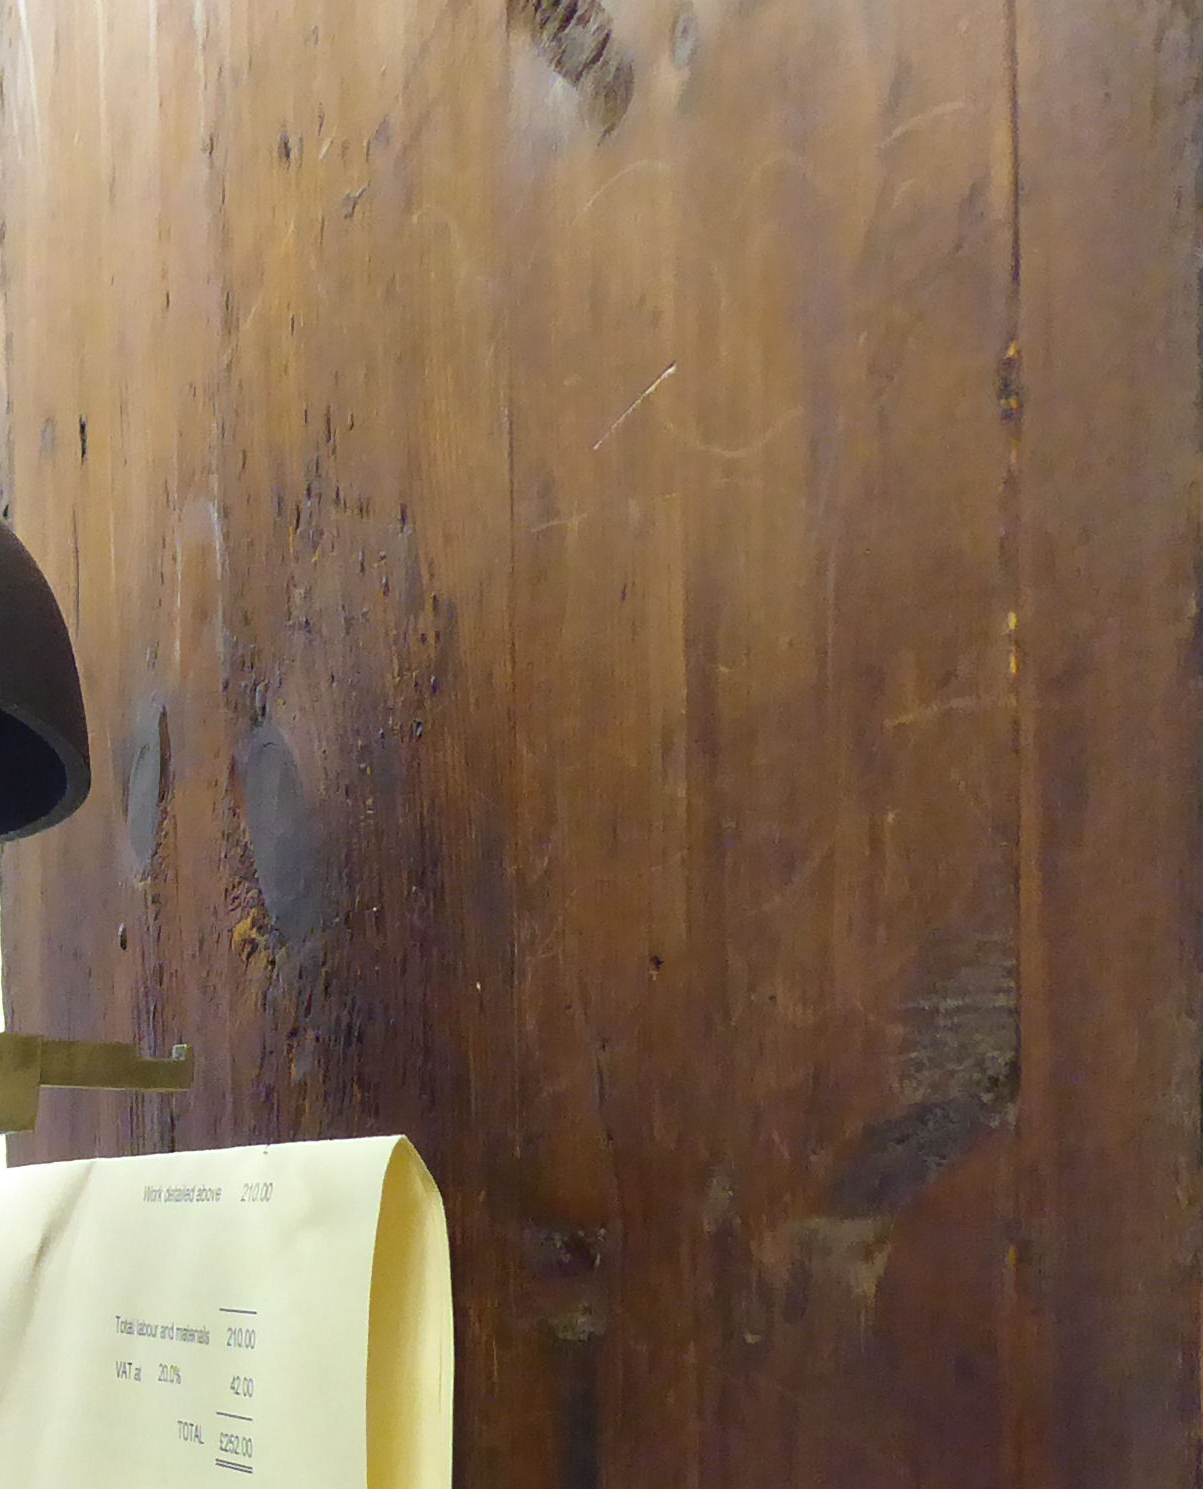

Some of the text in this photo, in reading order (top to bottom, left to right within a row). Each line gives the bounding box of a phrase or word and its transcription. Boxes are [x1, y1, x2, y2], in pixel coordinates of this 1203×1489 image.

[143, 1182, 274, 1203] Work detailed above 210.00
[115, 1315, 256, 1350] Total labour and materials 210.00
[115, 1360, 255, 1398] VAT at 20.0% 42.00
[177, 1420, 253, 1459] TOTAL £252.00
